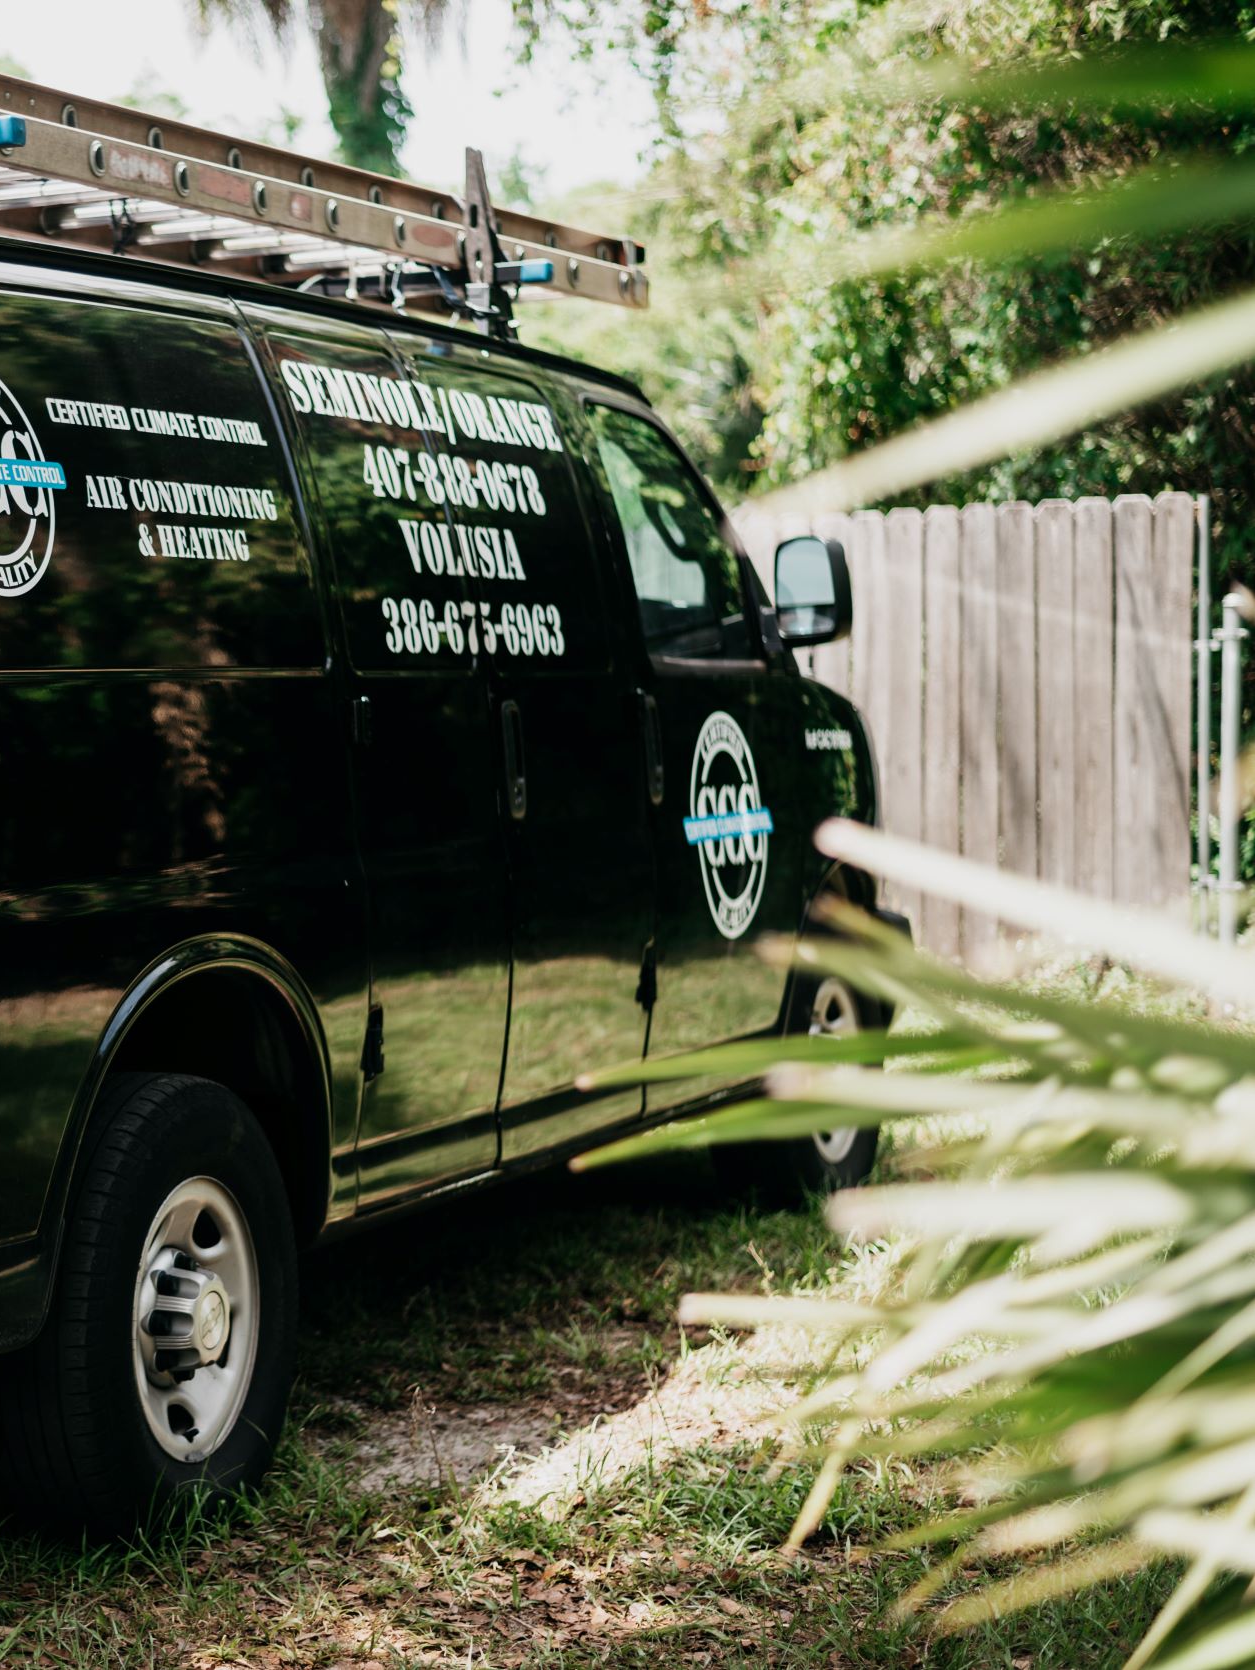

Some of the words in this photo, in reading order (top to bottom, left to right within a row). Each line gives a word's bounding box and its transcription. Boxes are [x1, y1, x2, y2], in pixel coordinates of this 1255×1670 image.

[45, 397, 131, 431] CERTIFIED
[131, 407, 200, 438] CLIMATE
[198, 415, 268, 447] CONTROL
[280, 359, 564, 453] SEMINOLE/ORANGE
[11, 464, 65, 485] CONTROL
[85, 474, 128, 510] AIR
[129, 478, 278, 522] CONDITIONING
[362, 444, 547, 517] 407-888-0678
[138, 524, 157, 558] &
[157, 525, 250, 562] HEATING
[398, 519, 526, 581] VOLUSIA
[381, 596, 565, 657] 386-675-6963
